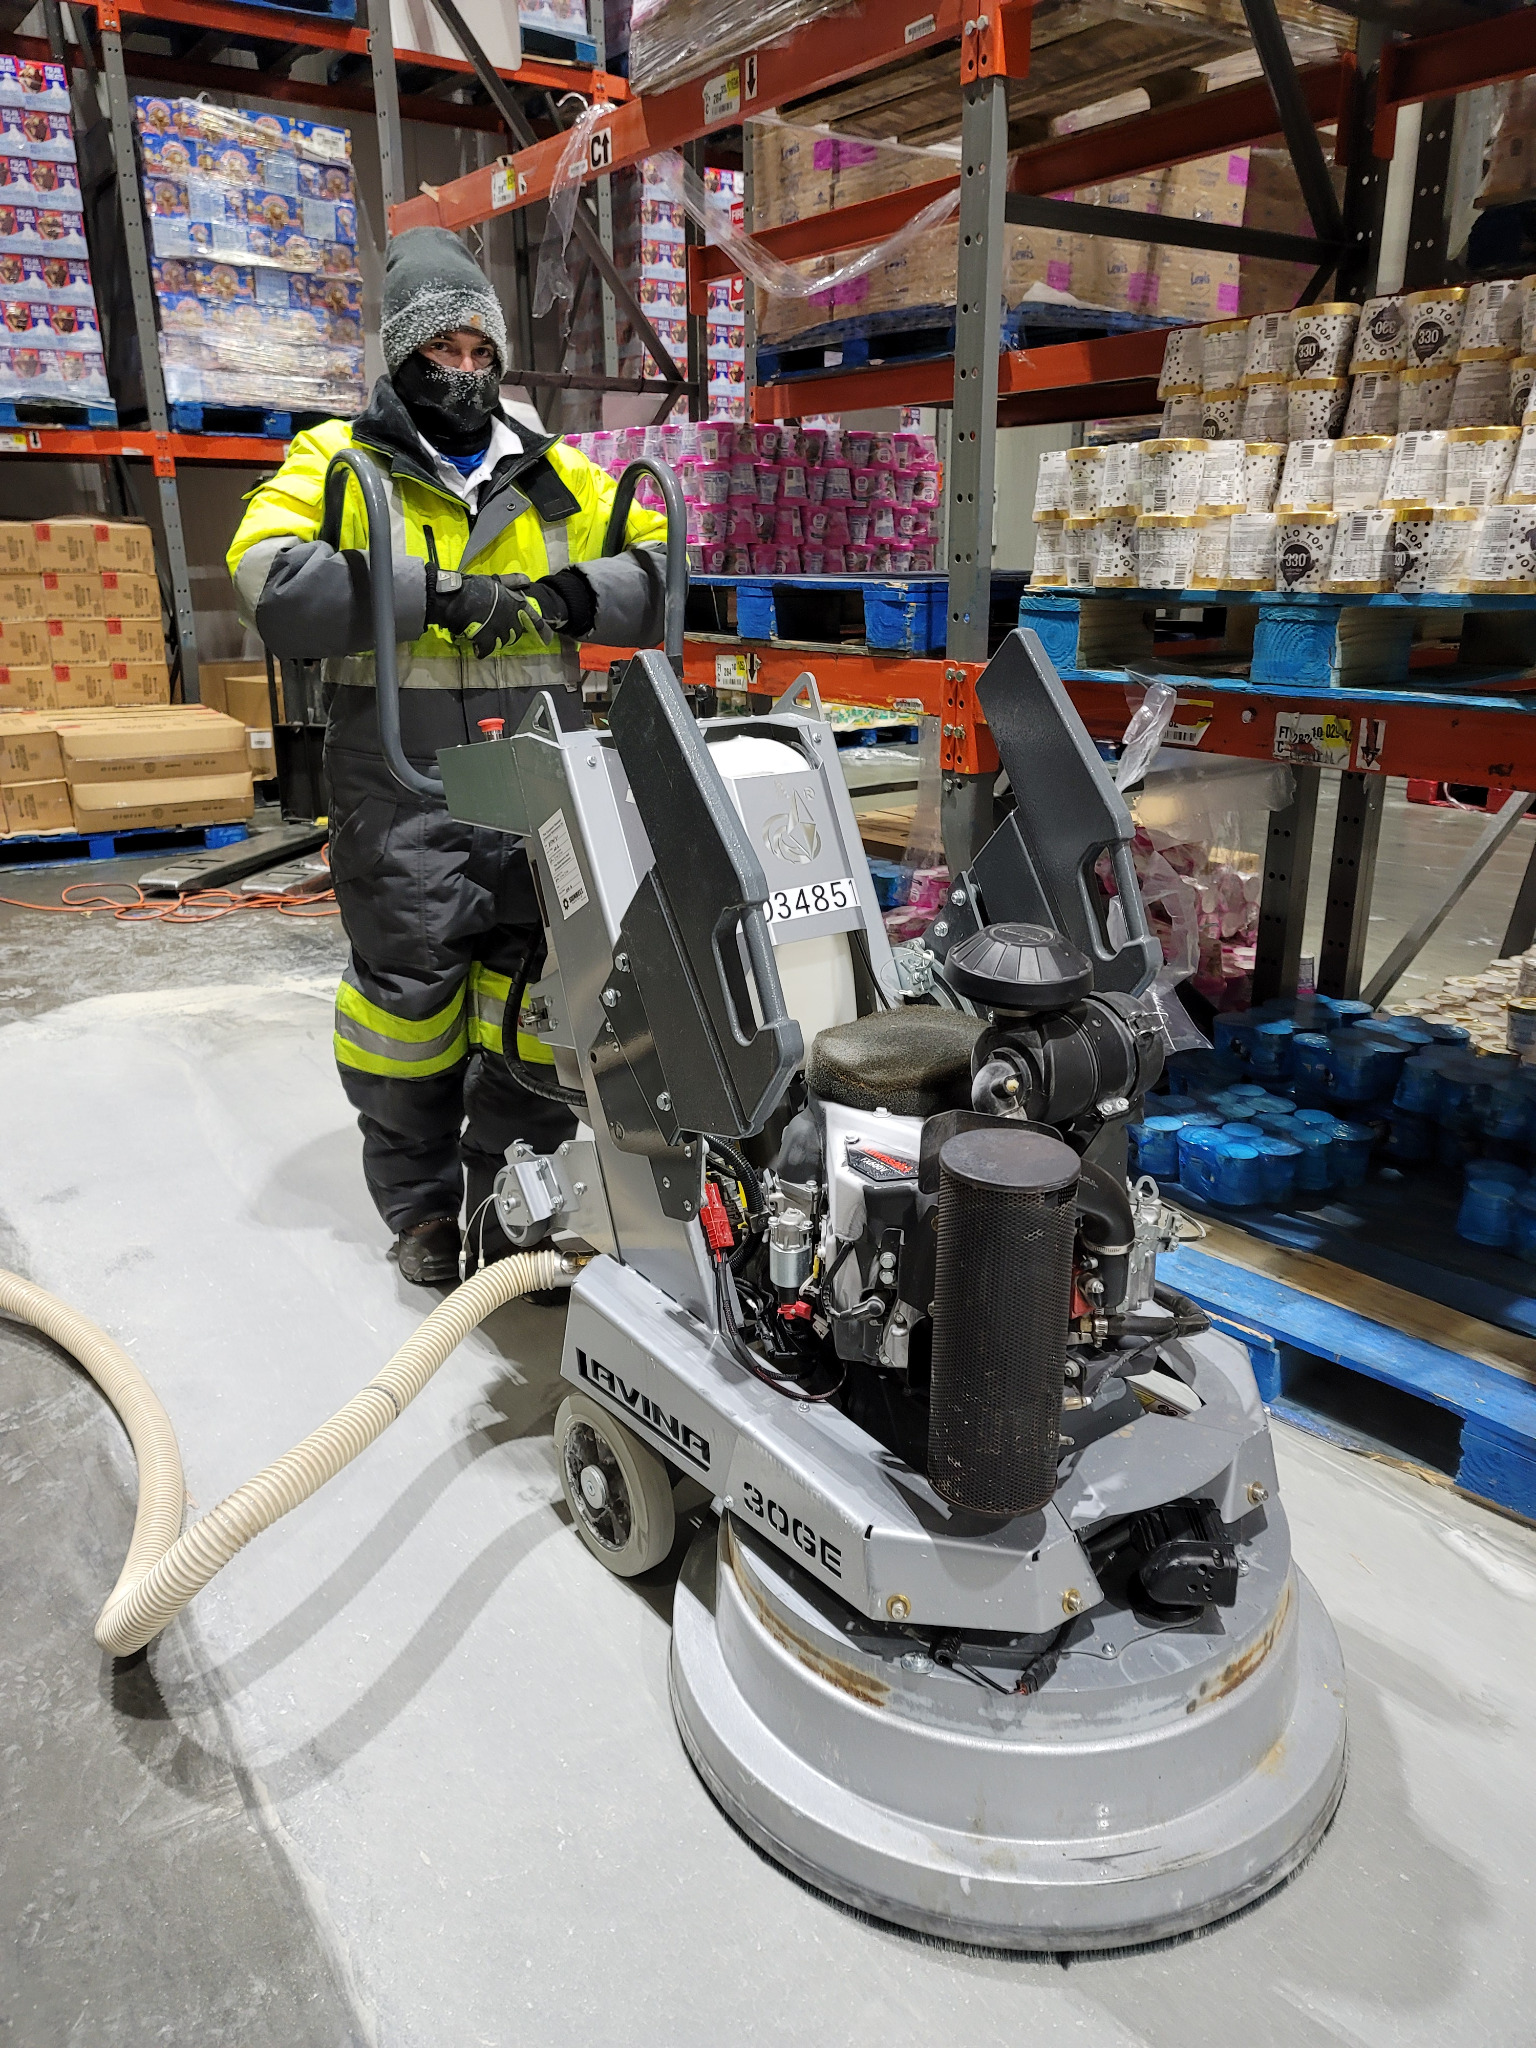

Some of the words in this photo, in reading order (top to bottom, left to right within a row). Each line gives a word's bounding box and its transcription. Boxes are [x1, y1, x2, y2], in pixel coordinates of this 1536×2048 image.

[591, 136, 601, 167] C
[1190, 271, 1211, 285] Lewis
[1439, 308, 1455, 326] TOP
[1315, 323, 1331, 341] TOP
[1418, 329, 1439, 345] 330
[1298, 343, 1316, 358] 330
[1215, 407, 1229, 423] TOP
[1277, 529, 1300, 551] HALO
[1306, 531, 1323, 551] TOP
[1405, 529, 1423, 550] TOP
[1120, 554, 1134, 572] TOP
[1285, 553, 1307, 567] 330
[1279, 726, 1289, 739] FT
[1312, 726, 1323, 738] 10
[1277, 741, 1284, 753] C
[576, 1347, 710, 1467] LAVINA
[743, 1482, 842, 1579] 30GE
